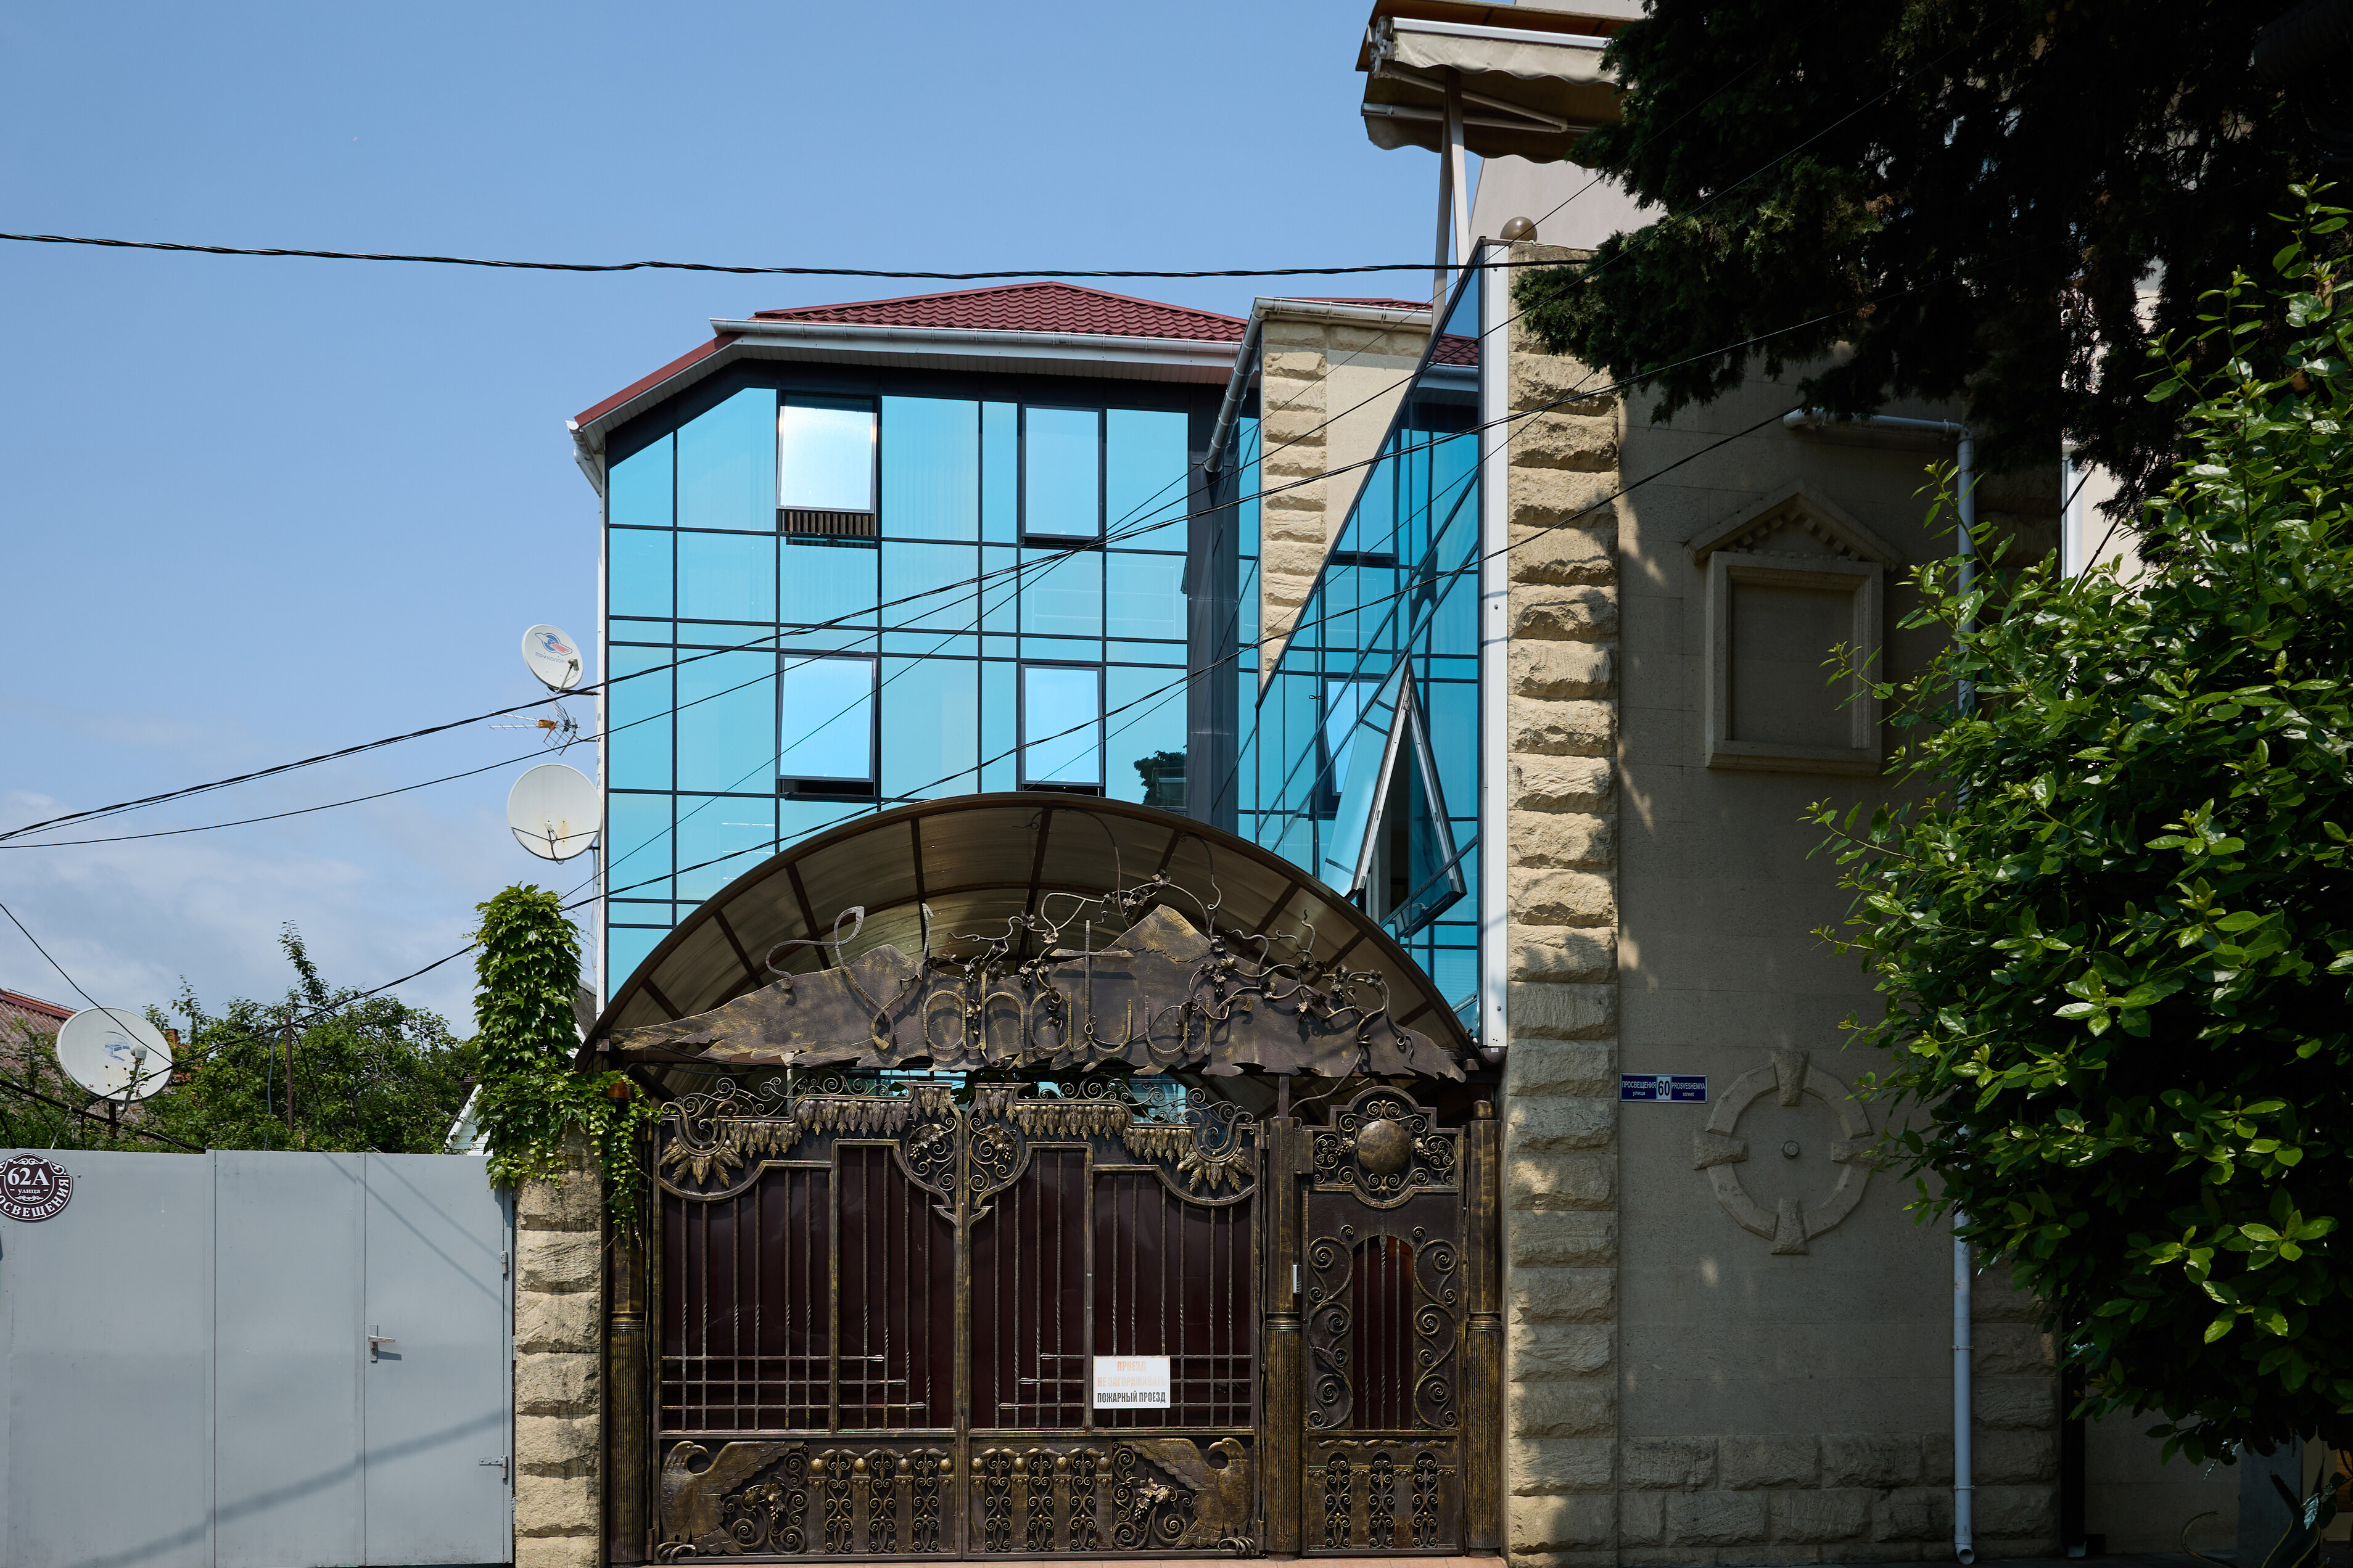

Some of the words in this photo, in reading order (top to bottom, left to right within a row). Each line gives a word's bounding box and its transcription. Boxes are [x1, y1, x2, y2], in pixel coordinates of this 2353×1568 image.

[1622, 1081, 1656, 1090] ПРОСВЕЩЕНИЯ
[1658, 1080, 1670, 1096] 60
[7, 1167, 51, 1185] 62А
[0, 1178, 69, 1217] ОСВЕЩЕНИЯ
[1117, 1361, 1147, 1373] ПРОЕЗД
[1097, 1376, 1106, 1387] НЕ
[1108, 1376, 1166, 1387] ЗАГОРАЖИВАТЬ
[1097, 1390, 1137, 1403] ПОЖАРНЫЙ
[1139, 1392, 1166, 1403] ПРОЕЗД
